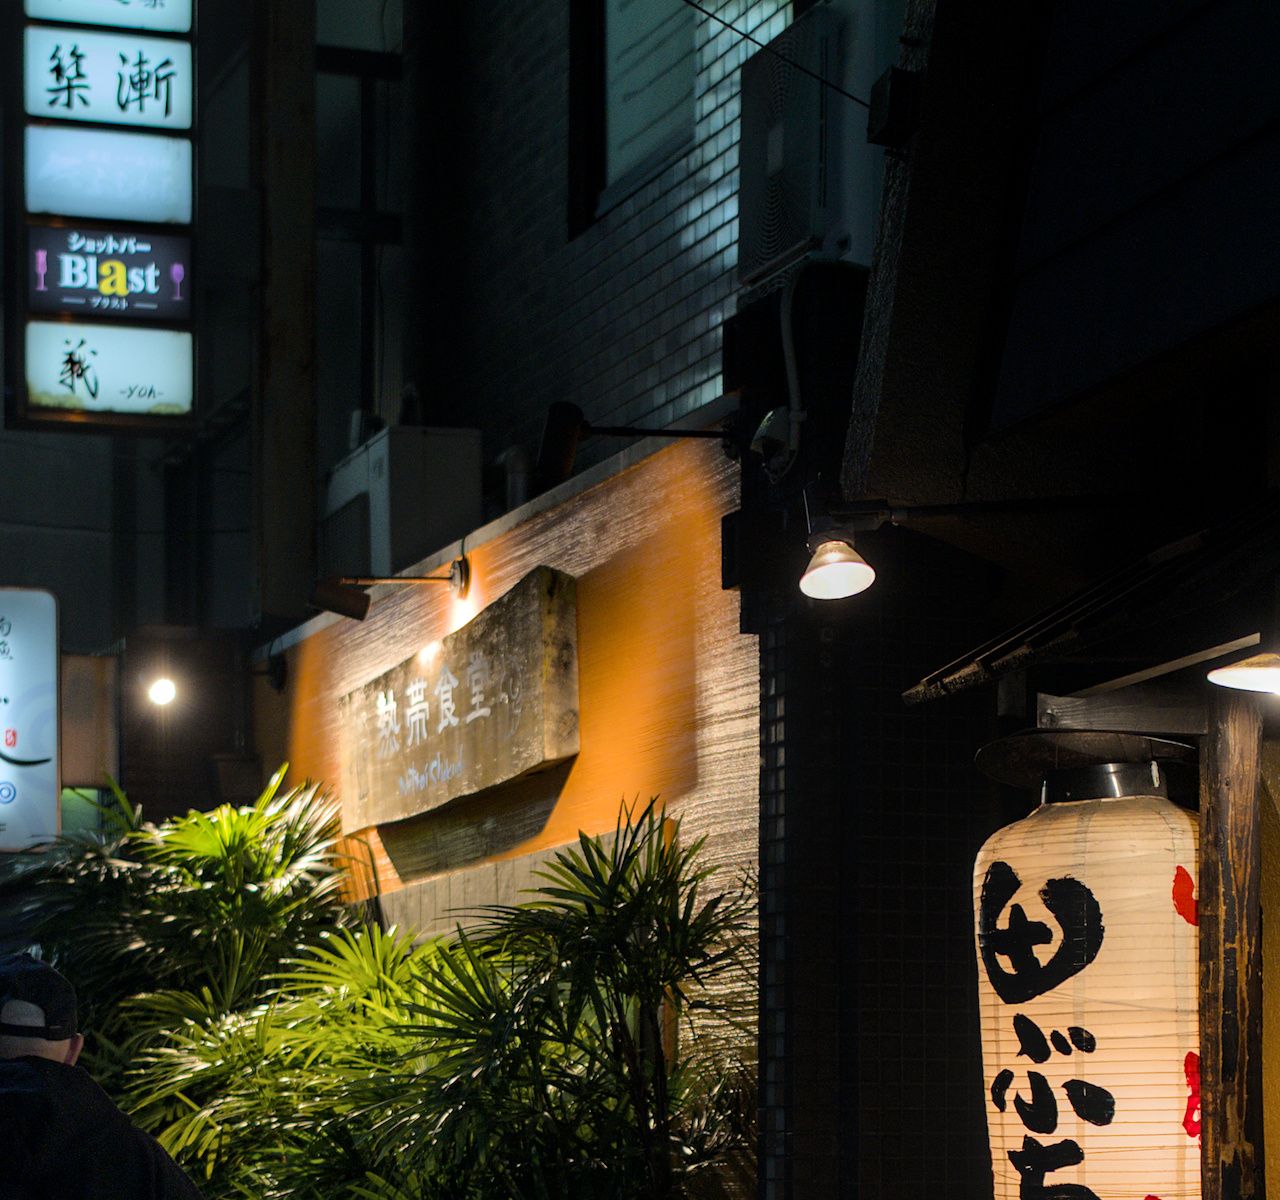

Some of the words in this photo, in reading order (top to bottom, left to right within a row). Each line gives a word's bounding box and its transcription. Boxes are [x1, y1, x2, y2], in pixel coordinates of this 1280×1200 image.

[67, 231, 152, 255] ショットバー
[58, 253, 160, 298] Blast
